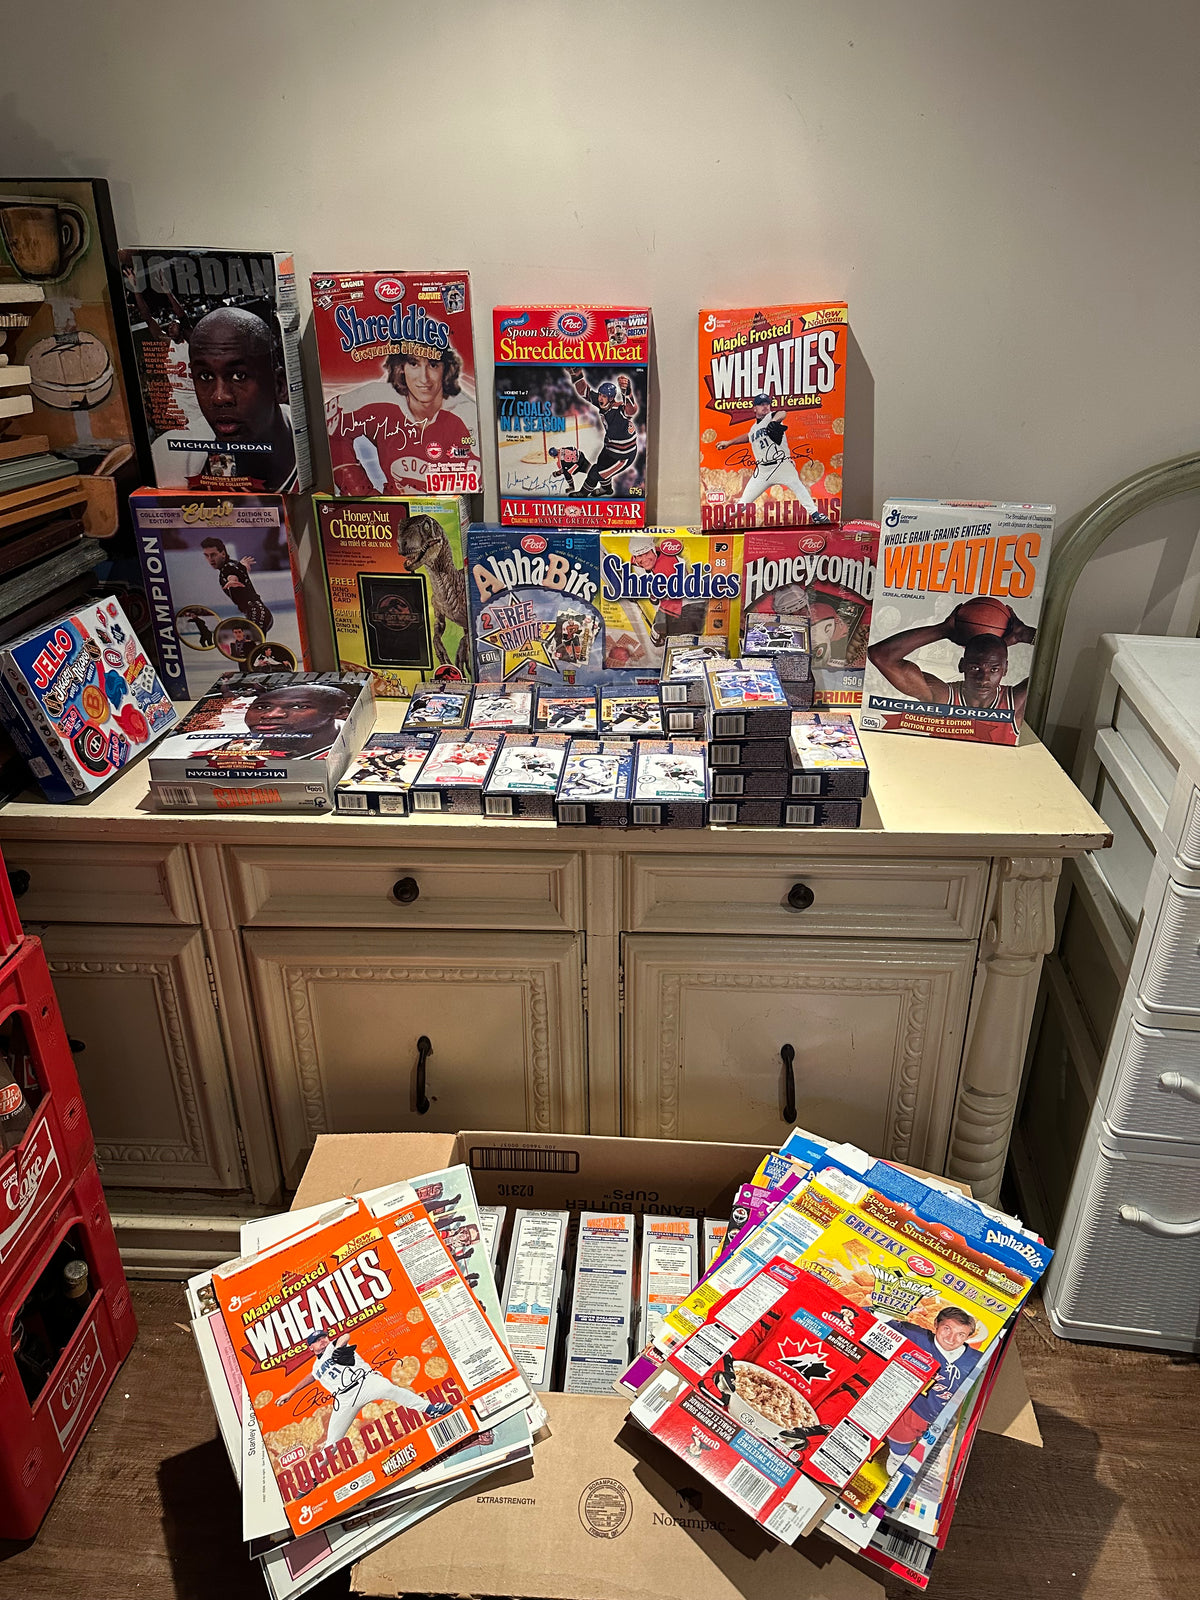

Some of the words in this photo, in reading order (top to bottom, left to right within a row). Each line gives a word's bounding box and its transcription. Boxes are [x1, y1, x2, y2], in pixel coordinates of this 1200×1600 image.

[126, 256, 274, 296] JORDAN
[341, 280, 365, 289] GAGNER
[380, 284, 400, 297] Post
[628, 319, 647, 328] WIN
[807, 316, 844, 327] Nouveau
[816, 309, 841, 320] New
[335, 303, 448, 352] Shreddies
[507, 327, 538, 340] Spoon
[539, 328, 560, 339] Size
[563, 321, 582, 331] Post
[713, 333, 748, 353] Maple
[748, 319, 791, 344] Frosted
[351, 344, 400, 362] Croquantes
[500, 338, 585, 362] Shredded
[587, 341, 643, 362] Wheat
[711, 330, 836, 400] WHEATIES
[500, 395, 515, 417] 77
[517, 402, 552, 418] GOALS
[714, 399, 754, 410] Givrées
[780, 394, 822, 405] l'érable
[500, 416, 512, 434] IN
[514, 419, 525, 434] A
[527, 419, 566, 435] SEASON
[170, 440, 223, 450] MICHAEL
[227, 442, 273, 452] JORDAN
[758, 438, 768, 449] 21
[427, 472, 479, 494] 1977-78
[181, 499, 234, 525] Elvis
[343, 509, 371, 524] Honey
[373, 511, 389, 523] Nut
[503, 504, 529, 519] ALL
[532, 505, 565, 519] TIME
[580, 506, 607, 520] ALL
[607, 506, 647, 521] STAR
[702, 501, 755, 528] ROGER
[236, 518, 275, 526] COLLECTION
[330, 519, 393, 540] Cheerios
[855, 534, 862, 543] 6
[884, 531, 913, 546] WHOLE
[961, 523, 996, 539] ENTIERS
[524, 539, 546, 550] Post
[565, 538, 574, 550] 9
[663, 541, 683, 553] Post
[801, 540, 823, 550] Post
[714, 558, 728, 570] 88
[884, 532, 1047, 598] WHEATIES
[330, 577, 356, 586] FREE!
[603, 553, 742, 602] Shreddies
[743, 555, 878, 611] Honeycomb
[141, 537, 182, 678] CHAMPION
[492, 602, 534, 630] FREE
[482, 613, 493, 630] 2
[498, 621, 542, 651] GRATUITE
[481, 651, 499, 662] FOIL
[513, 651, 541, 659] PINNACLE
[229, 672, 369, 684] JORDAN
[843, 676, 856, 686] 950
[871, 698, 948, 717] MICHAEL
[953, 707, 1017, 723] JORDAN
[904, 713, 950, 727] COLLECTOR'S
[950, 719, 977, 728] EDITION
[190, 733, 254, 741] MICHAEL
[257, 733, 312, 741] JORDAN
[930, 725, 939, 733] DE
[940, 725, 980, 737] COLLECTION
[187, 771, 232, 780] JORDAN
[234, 771, 286, 779] MICHAEL
[212, 787, 283, 809] WHEATIES
[3, 1087, 15, 1100] Dr
[3, 1171, 18, 1189] Enjoy
[6, 1155, 44, 1211] Coke
[565, 1199, 632, 1213] BUTTER
[634, 1202, 707, 1217] PEANUT
[801, 1199, 823, 1220] Wheat
[804, 1192, 837, 1221] Shredded
[586, 1216, 626, 1230] WHEATIES
[866, 1205, 899, 1229] Toasted
[650, 1221, 690, 1235] WHEATIES
[844, 1214, 908, 1257] GRETZKY
[341, 1238, 378, 1265] Nouveau
[346, 1233, 374, 1255] New
[900, 1222, 951, 1258] Shredded
[951, 1250, 985, 1278] Wheat
[869, 1264, 898, 1286] WIN
[909, 1257, 934, 1275] Post
[941, 1272, 967, 1292] 99
[241, 1297, 283, 1328] Maple
[281, 1264, 328, 1304] Frosted
[870, 1288, 917, 1315] GRETZKY
[890, 1287, 916, 1303] 999
[244, 1249, 394, 1362] WHEATIES
[795, 1318, 823, 1337] SWEETENED
[803, 1316, 822, 1330] LIGHTLY
[821, 1311, 856, 1339] QUAKER
[259, 1342, 308, 1371] Givrées
[327, 1327, 338, 1338] à
[338, 1303, 386, 1334] l'érable
[837, 1335, 854, 1348] MAPLE
[868, 1331, 895, 1352] PRIZES
[876, 1323, 903, 1344] 10,000
[827, 1336, 846, 1350] BROWN
[844, 1346, 862, 1361] SUGAR
[62, 1354, 93, 1411] Coke
[328, 1366, 342, 1381] 21
[768, 1360, 812, 1395] CANADA
[682, 1401, 699, 1415] SUGAR
[696, 1411, 714, 1426] BROWN
[691, 1424, 721, 1451] QUAKER
[714, 1425, 731, 1441] MAPLE
[247, 1428, 256, 1457] Stanley
[736, 1438, 768, 1464] SWEETENED
[280, 1448, 297, 1465] 400
[381, 1443, 417, 1476] WHEATIES
[276, 1436, 358, 1503] ROGER
[764, 1460, 787, 1481] LIGHTLY
[588, 1479, 618, 1492] NORAMPAC
[311, 1498, 328, 1510] General
[477, 1496, 536, 1506] EXTRASTRENGTH
[844, 1489, 857, 1501] 620
[651, 1511, 727, 1531] Norampac
[906, 1570, 919, 1583] 400
